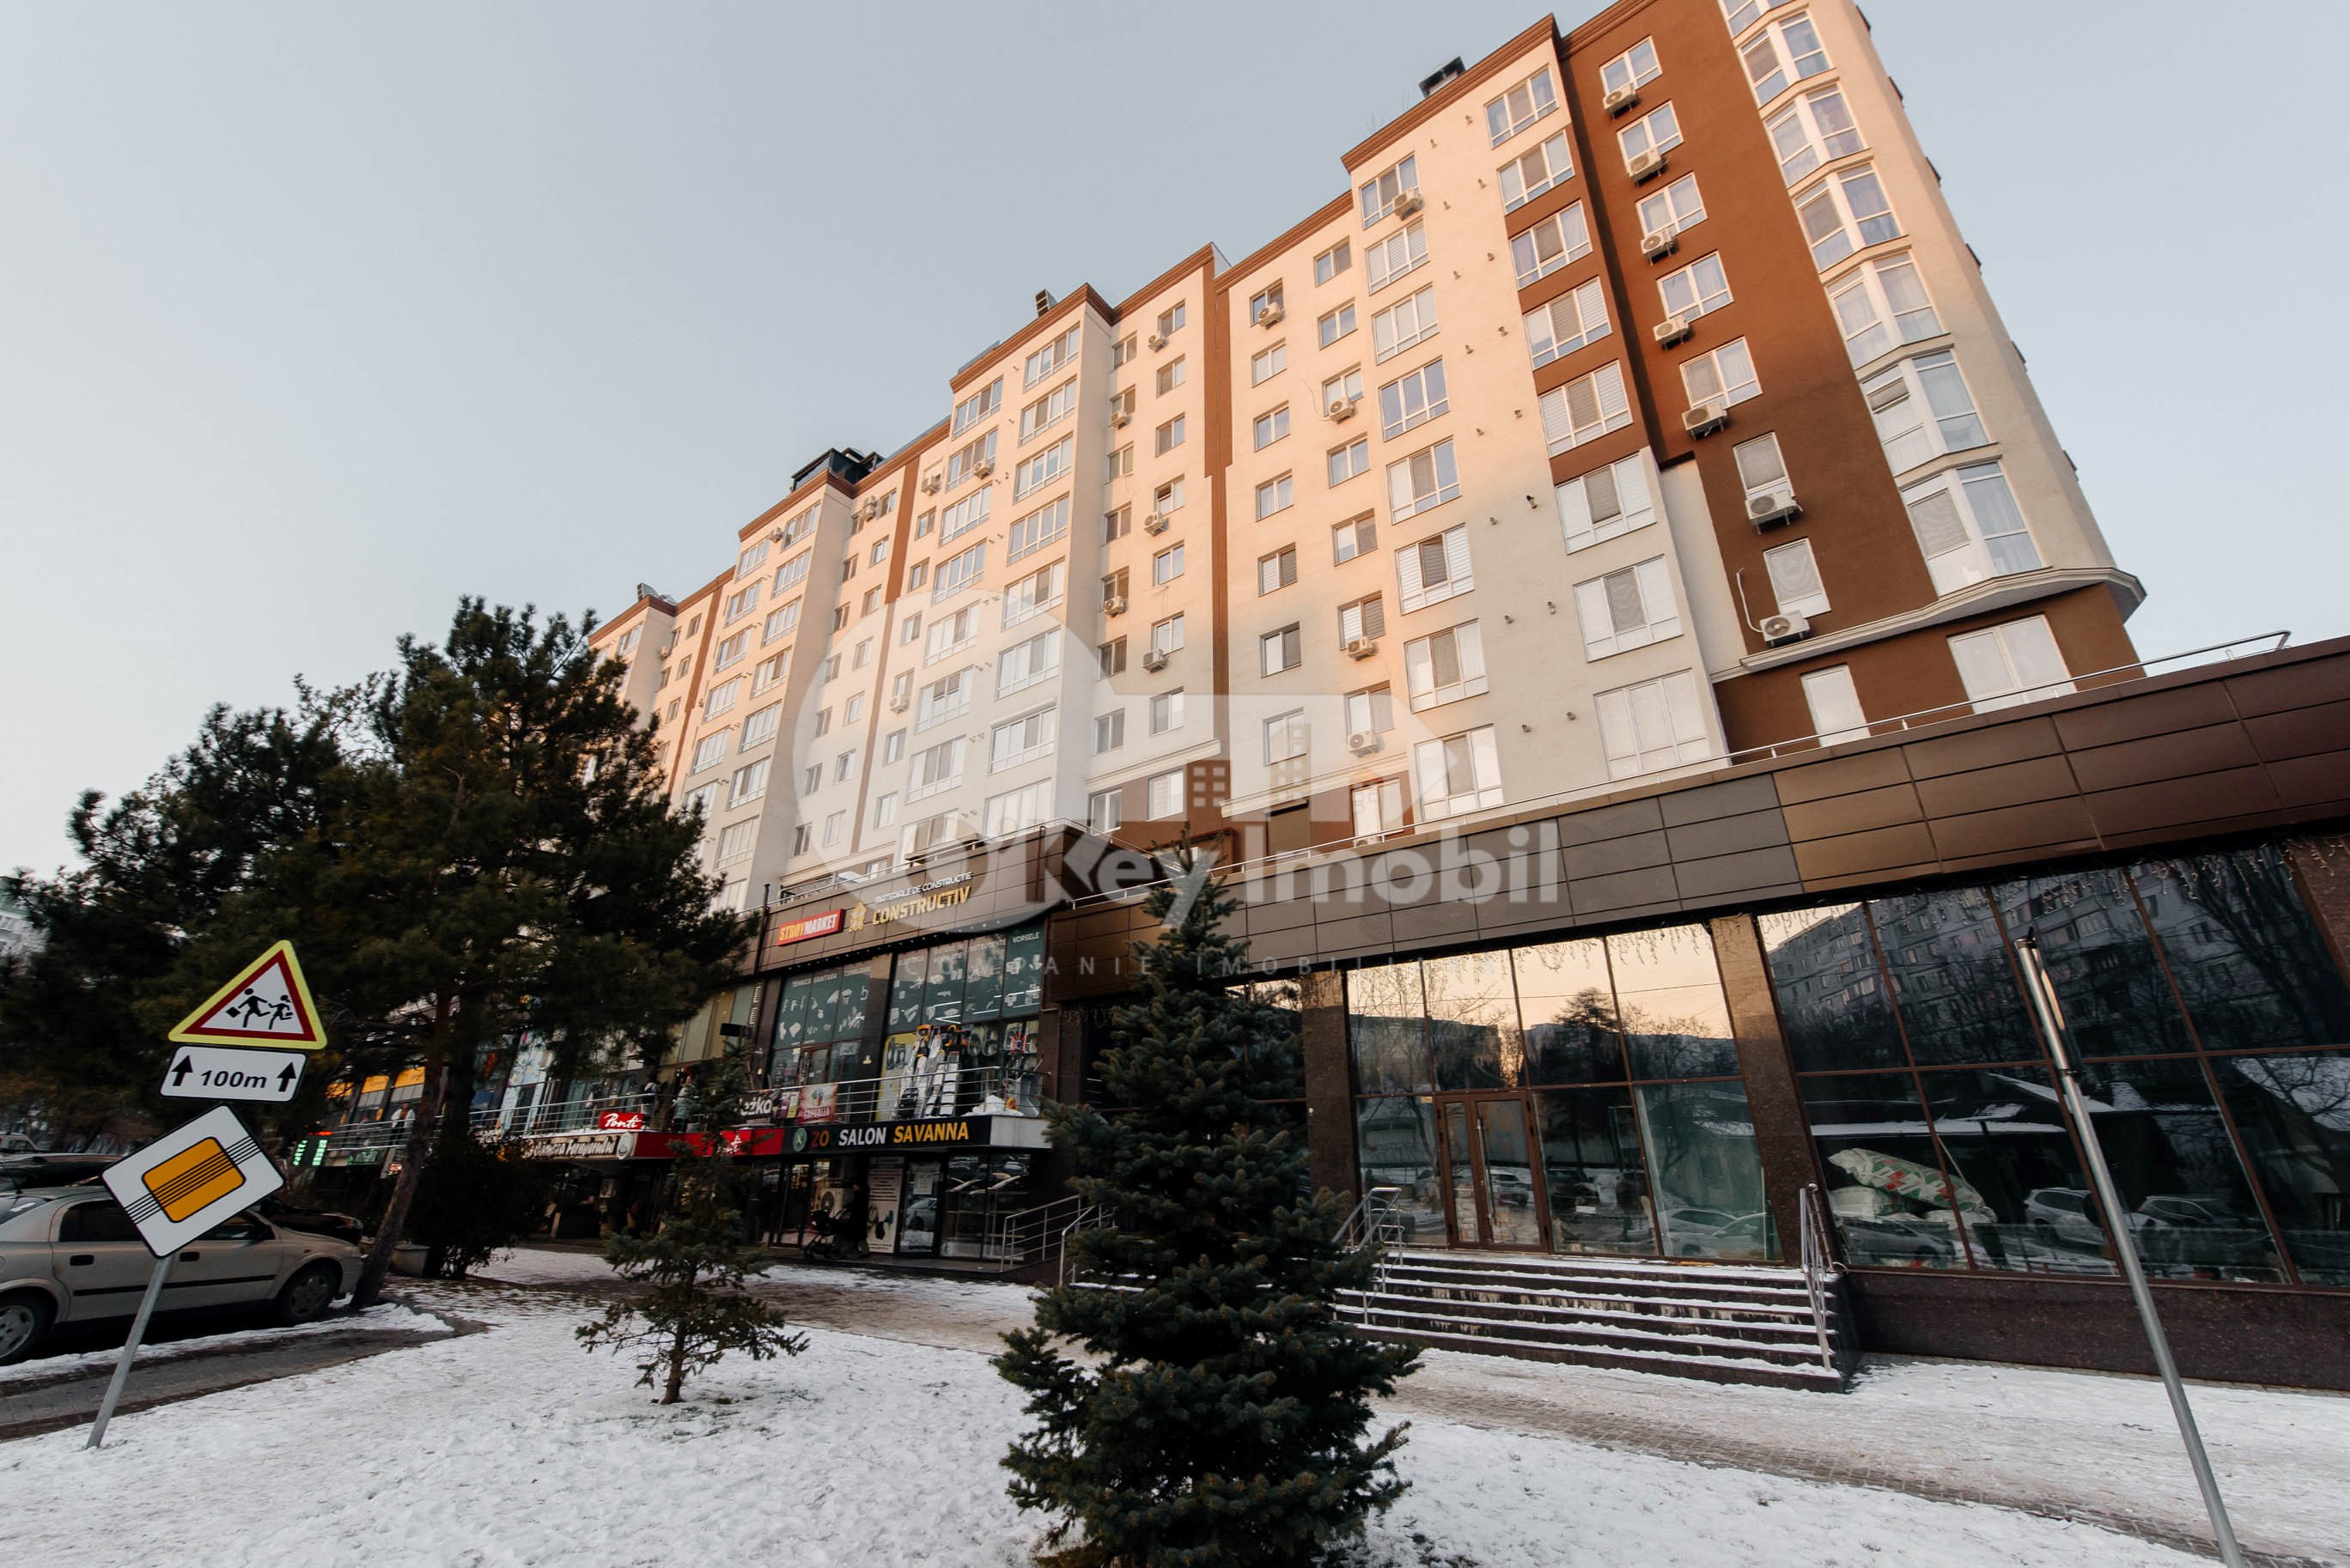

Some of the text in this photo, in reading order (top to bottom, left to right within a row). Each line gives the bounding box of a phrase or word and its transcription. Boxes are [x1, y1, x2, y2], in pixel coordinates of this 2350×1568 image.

[912, 885, 922, 895] DE
[872, 886, 971, 925] CONSTRUCTIV
[779, 913, 838, 941] STROYMARKET
[1013, 933, 1040, 944] VOPSELE
[201, 1070, 267, 1089] 100m
[604, 1113, 642, 1129] Ponti
[893, 1121, 970, 1143] SAVANNA
